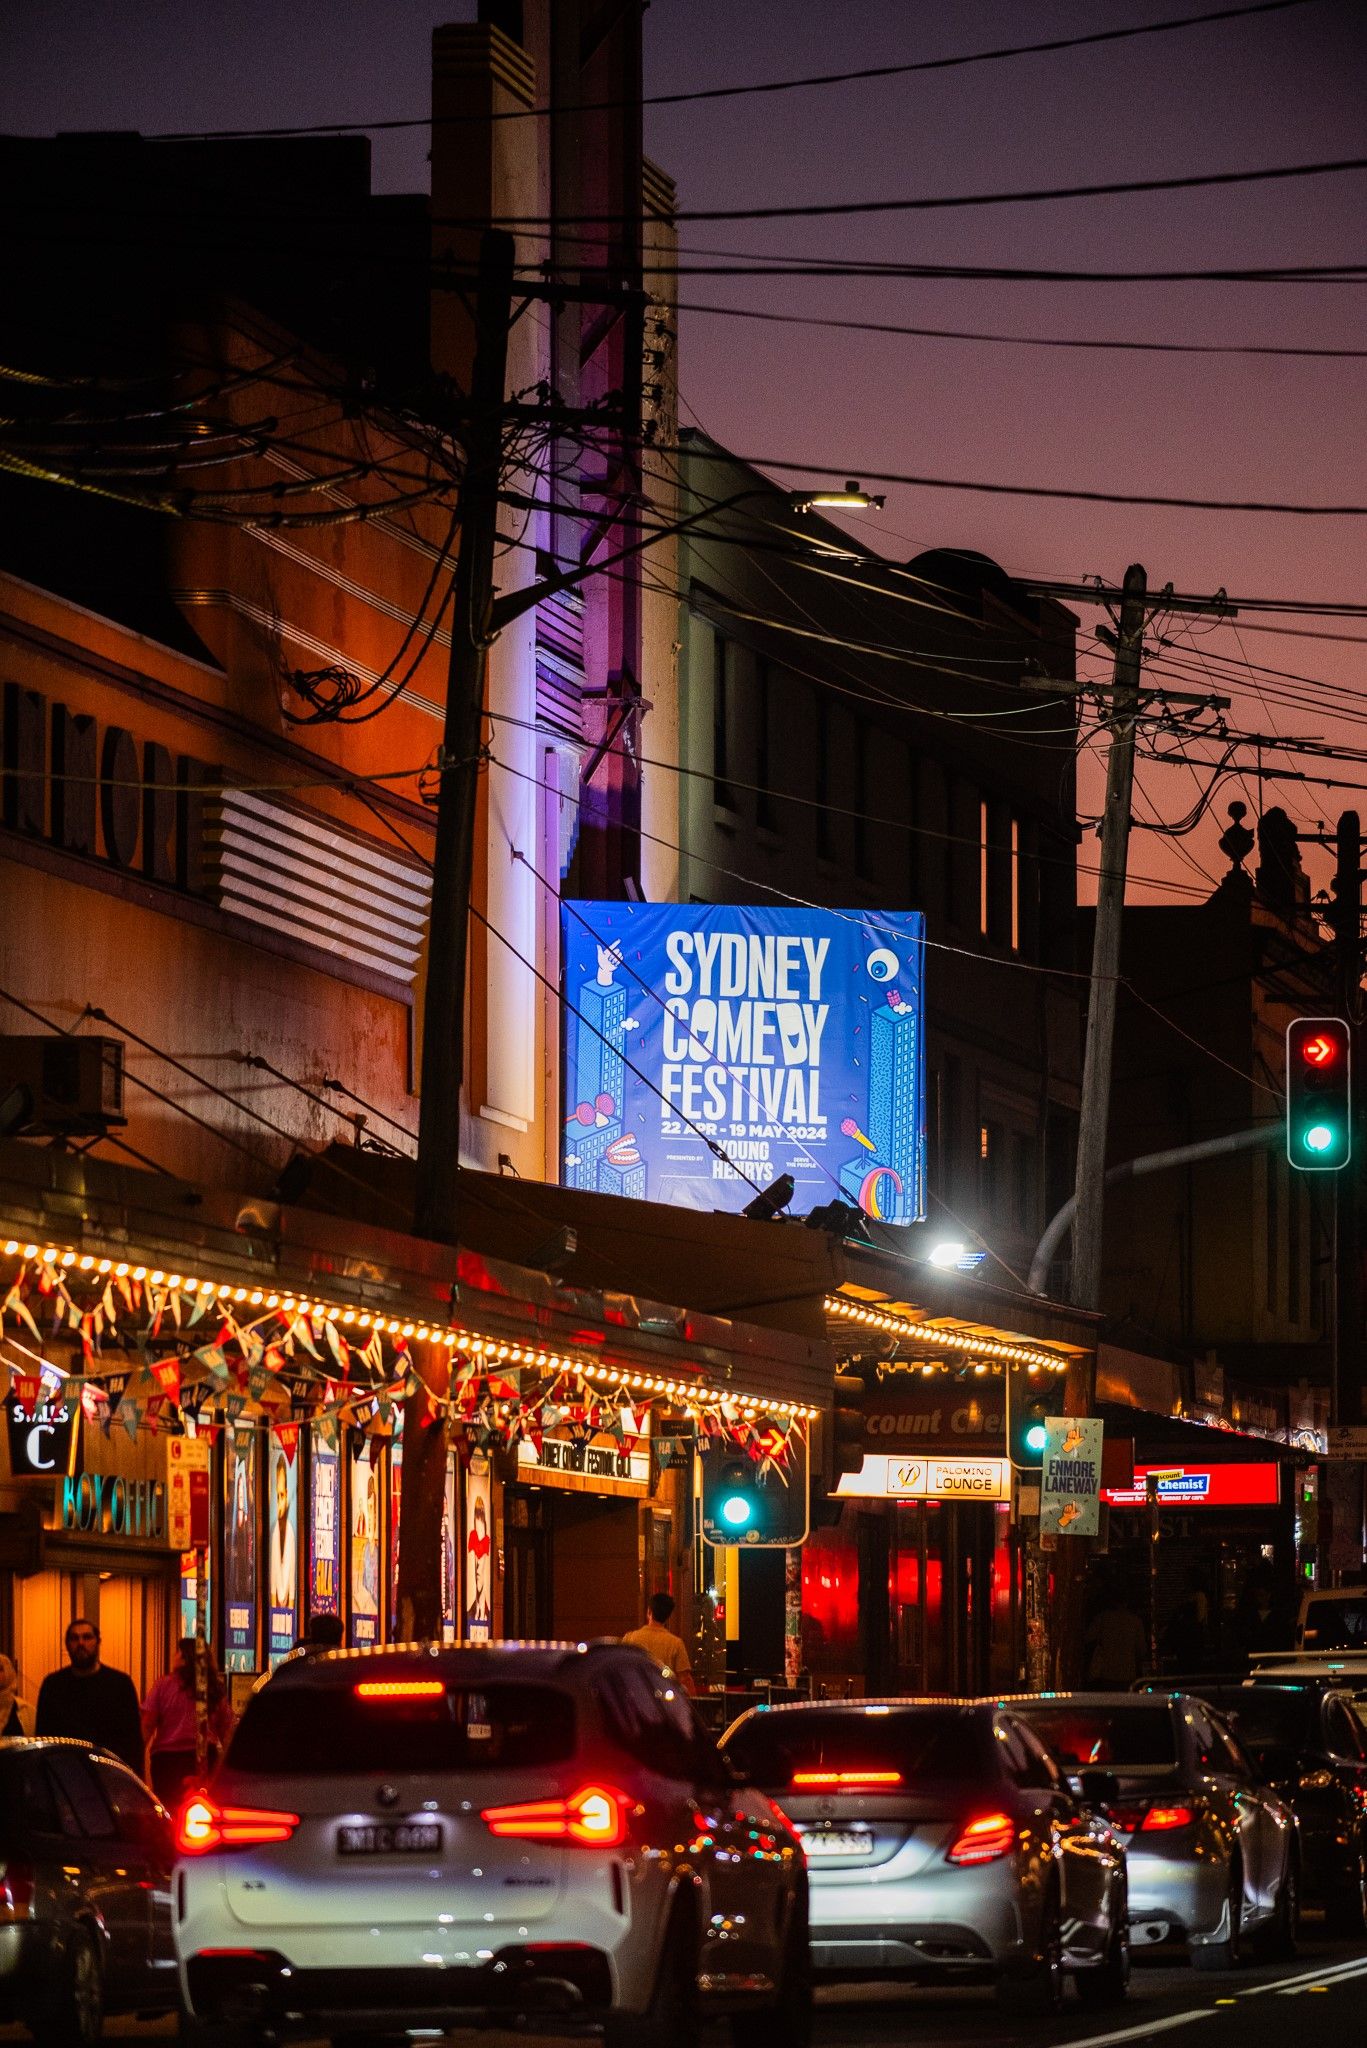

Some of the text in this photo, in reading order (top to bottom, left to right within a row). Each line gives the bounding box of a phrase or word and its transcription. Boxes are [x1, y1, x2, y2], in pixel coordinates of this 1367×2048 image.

[664, 930, 831, 1001] SYDNEY
[662, 997, 830, 1067] COMEDY
[660, 1063, 828, 1125] FESTIVAL
[660, 1121, 681, 1135] 22
[683, 1122, 718, 1136] APR
[729, 1124, 747, 1137] 19
[748, 1125, 785, 1139] MAY
[787, 1126, 828, 1140] 2024
[716, 1139, 770, 1161] YOUNG
[711, 1160, 774, 1181] HENRYS
[109, 1377, 124, 1393] HA
[13, 1404, 70, 1423] SLLS
[864, 1408, 944, 1435] count
[281, 1429, 296, 1445] HA
[698, 1438, 710, 1452] HA
[26, 1424, 56, 1470] C
[658, 1441, 671, 1455] HA
[936, 1466, 993, 1476] PALOMINO
[1048, 1459, 1096, 1479] ENMORE
[1158, 1472, 1181, 1480] scount
[935, 1477, 993, 1490] LOUNGE
[1044, 1475, 1098, 1495] LANEWAY
[1157, 1478, 1204, 1490] Chemist
[62, 1470, 110, 1537] BOX
